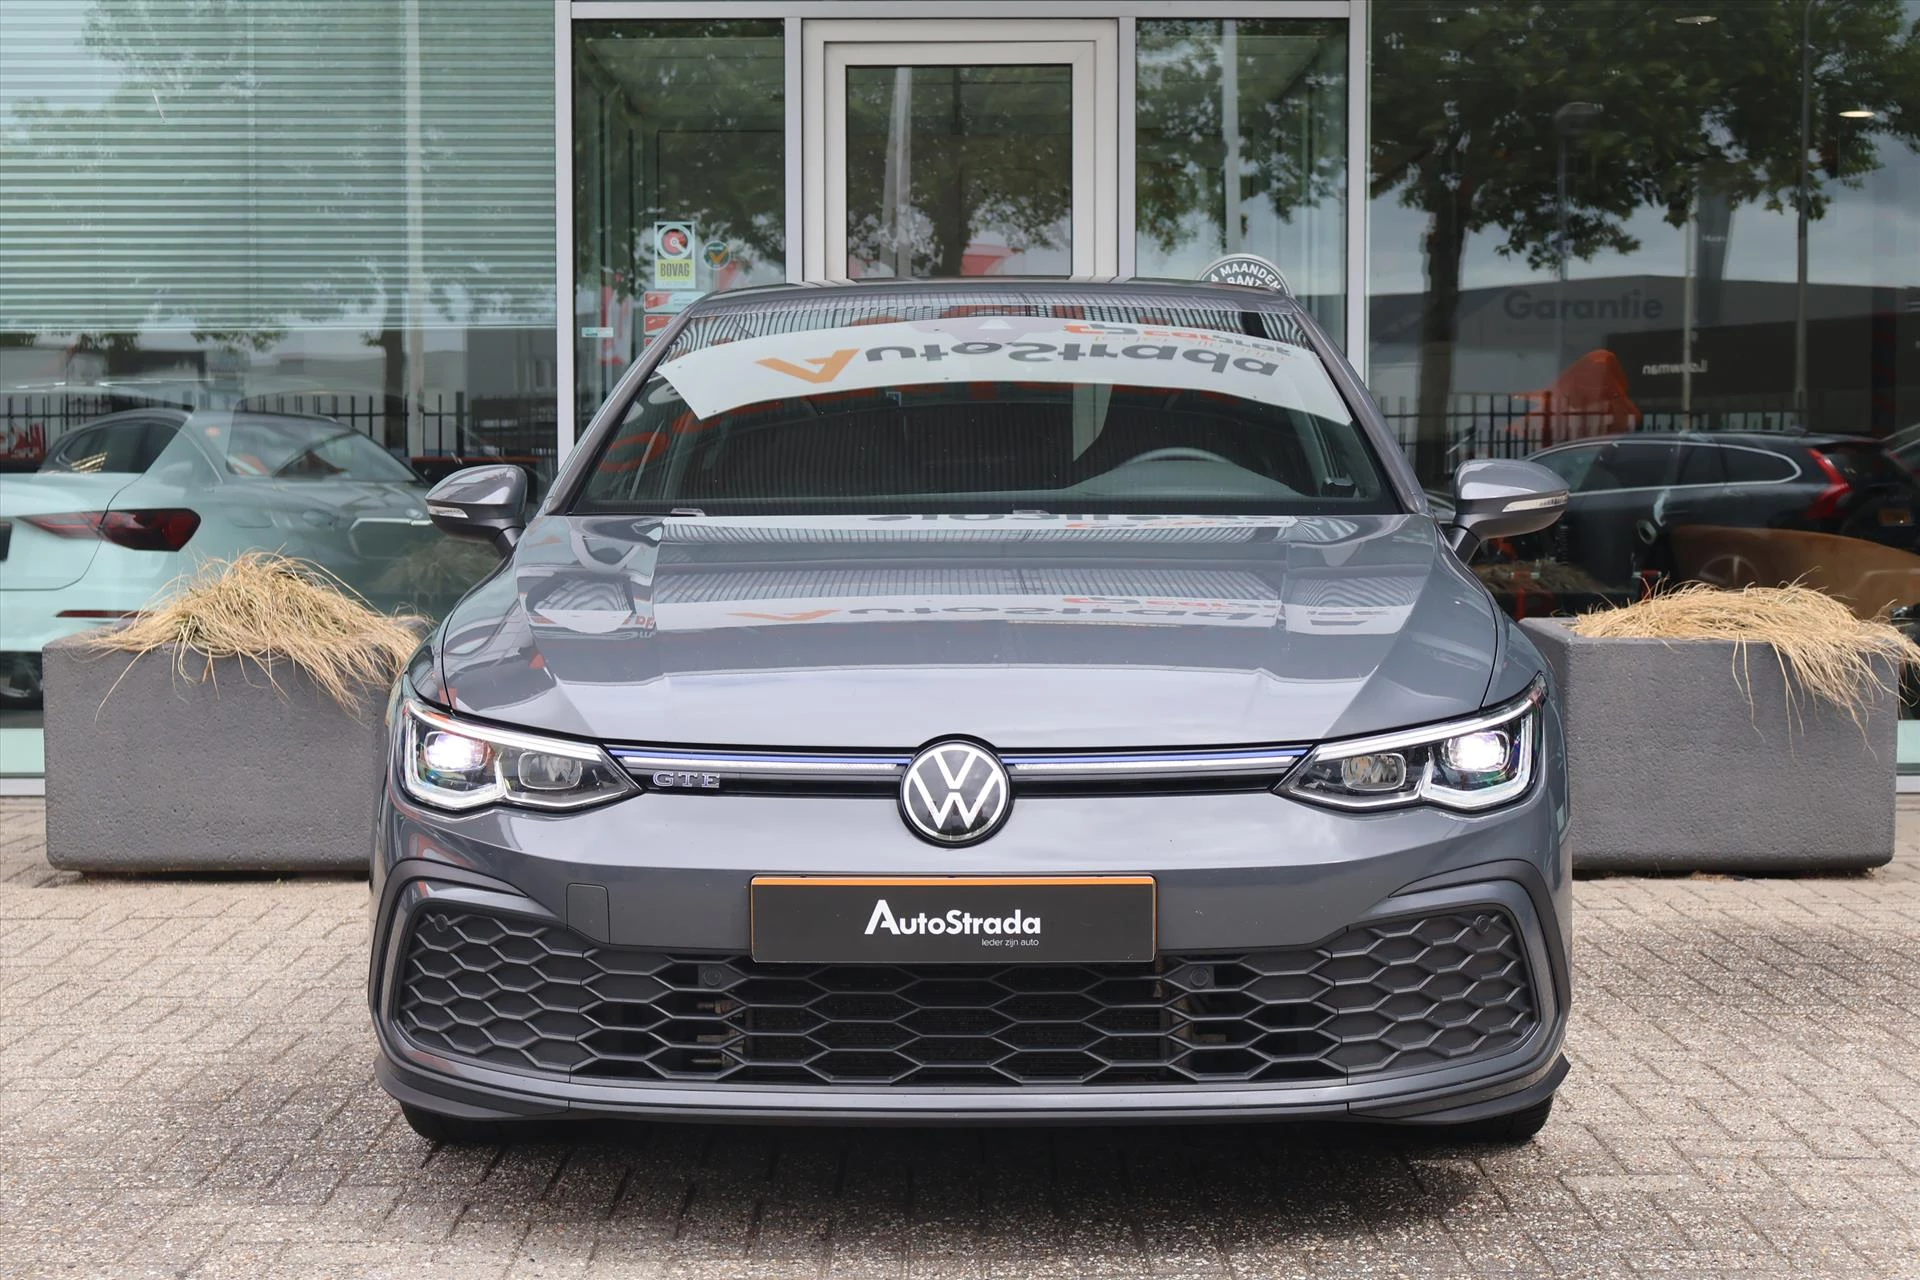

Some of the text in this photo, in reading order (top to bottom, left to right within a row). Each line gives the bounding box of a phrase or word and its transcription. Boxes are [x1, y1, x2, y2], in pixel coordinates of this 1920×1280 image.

[660, 263, 690, 277] BOVAG
[1220, 262, 1281, 289] MAANDEN
[1504, 289, 1664, 320] Garantie
[652, 771, 720, 788] GTE
[864, 899, 1041, 935] AutoStrada
[1005, 939, 1019, 948] zijn
